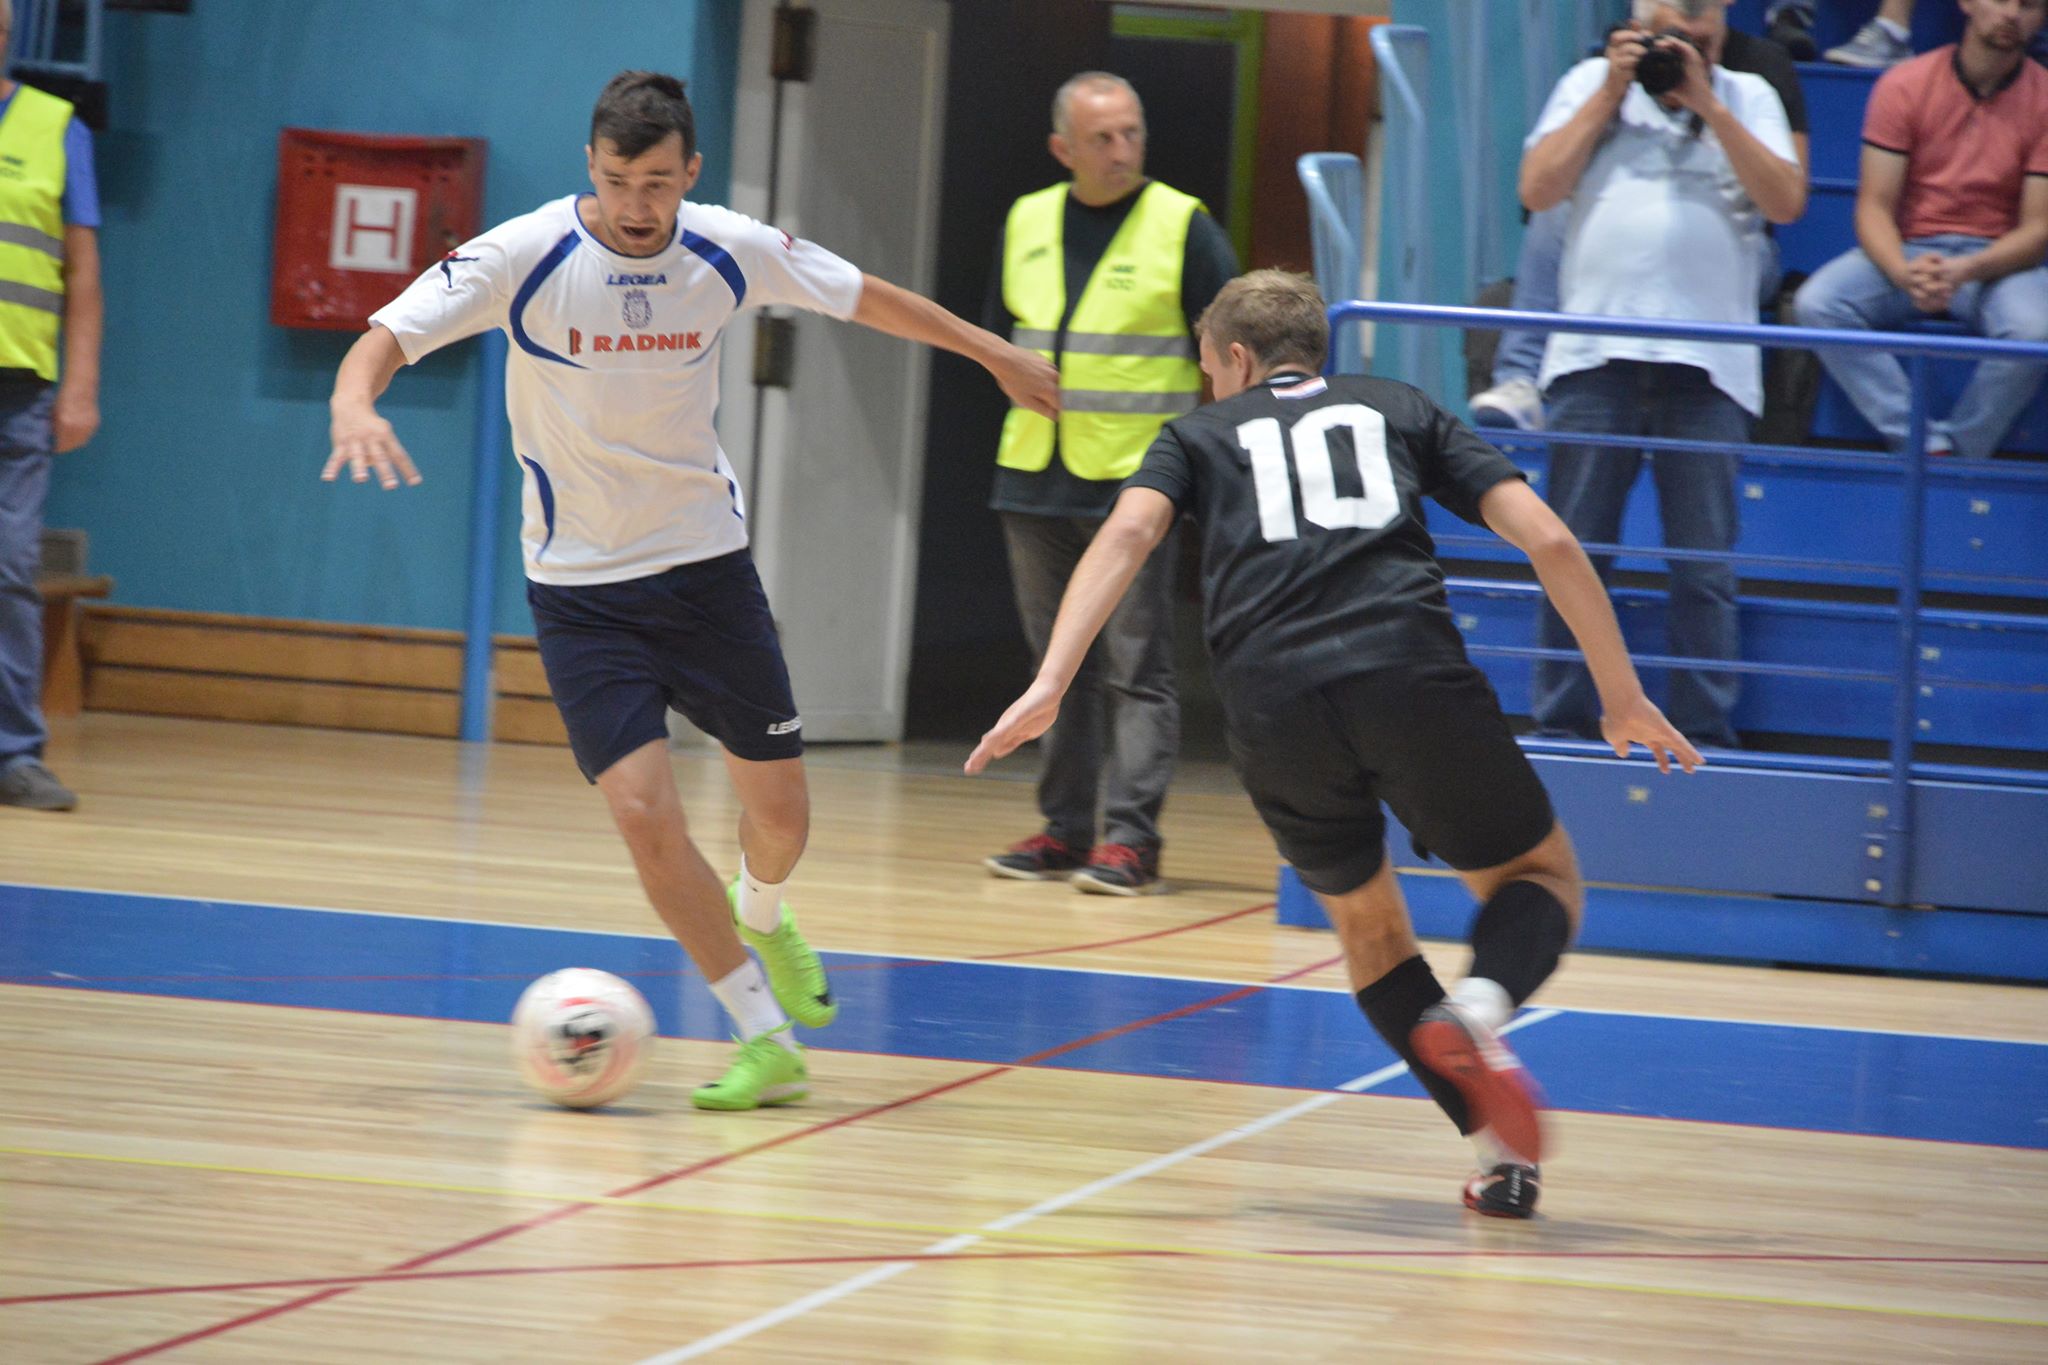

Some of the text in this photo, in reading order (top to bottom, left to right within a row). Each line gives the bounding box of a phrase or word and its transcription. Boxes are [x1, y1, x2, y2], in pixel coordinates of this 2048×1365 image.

[344, 197, 402, 261] H
[593, 332, 702, 352] RADNIK
[1236, 403, 1401, 543] 10
